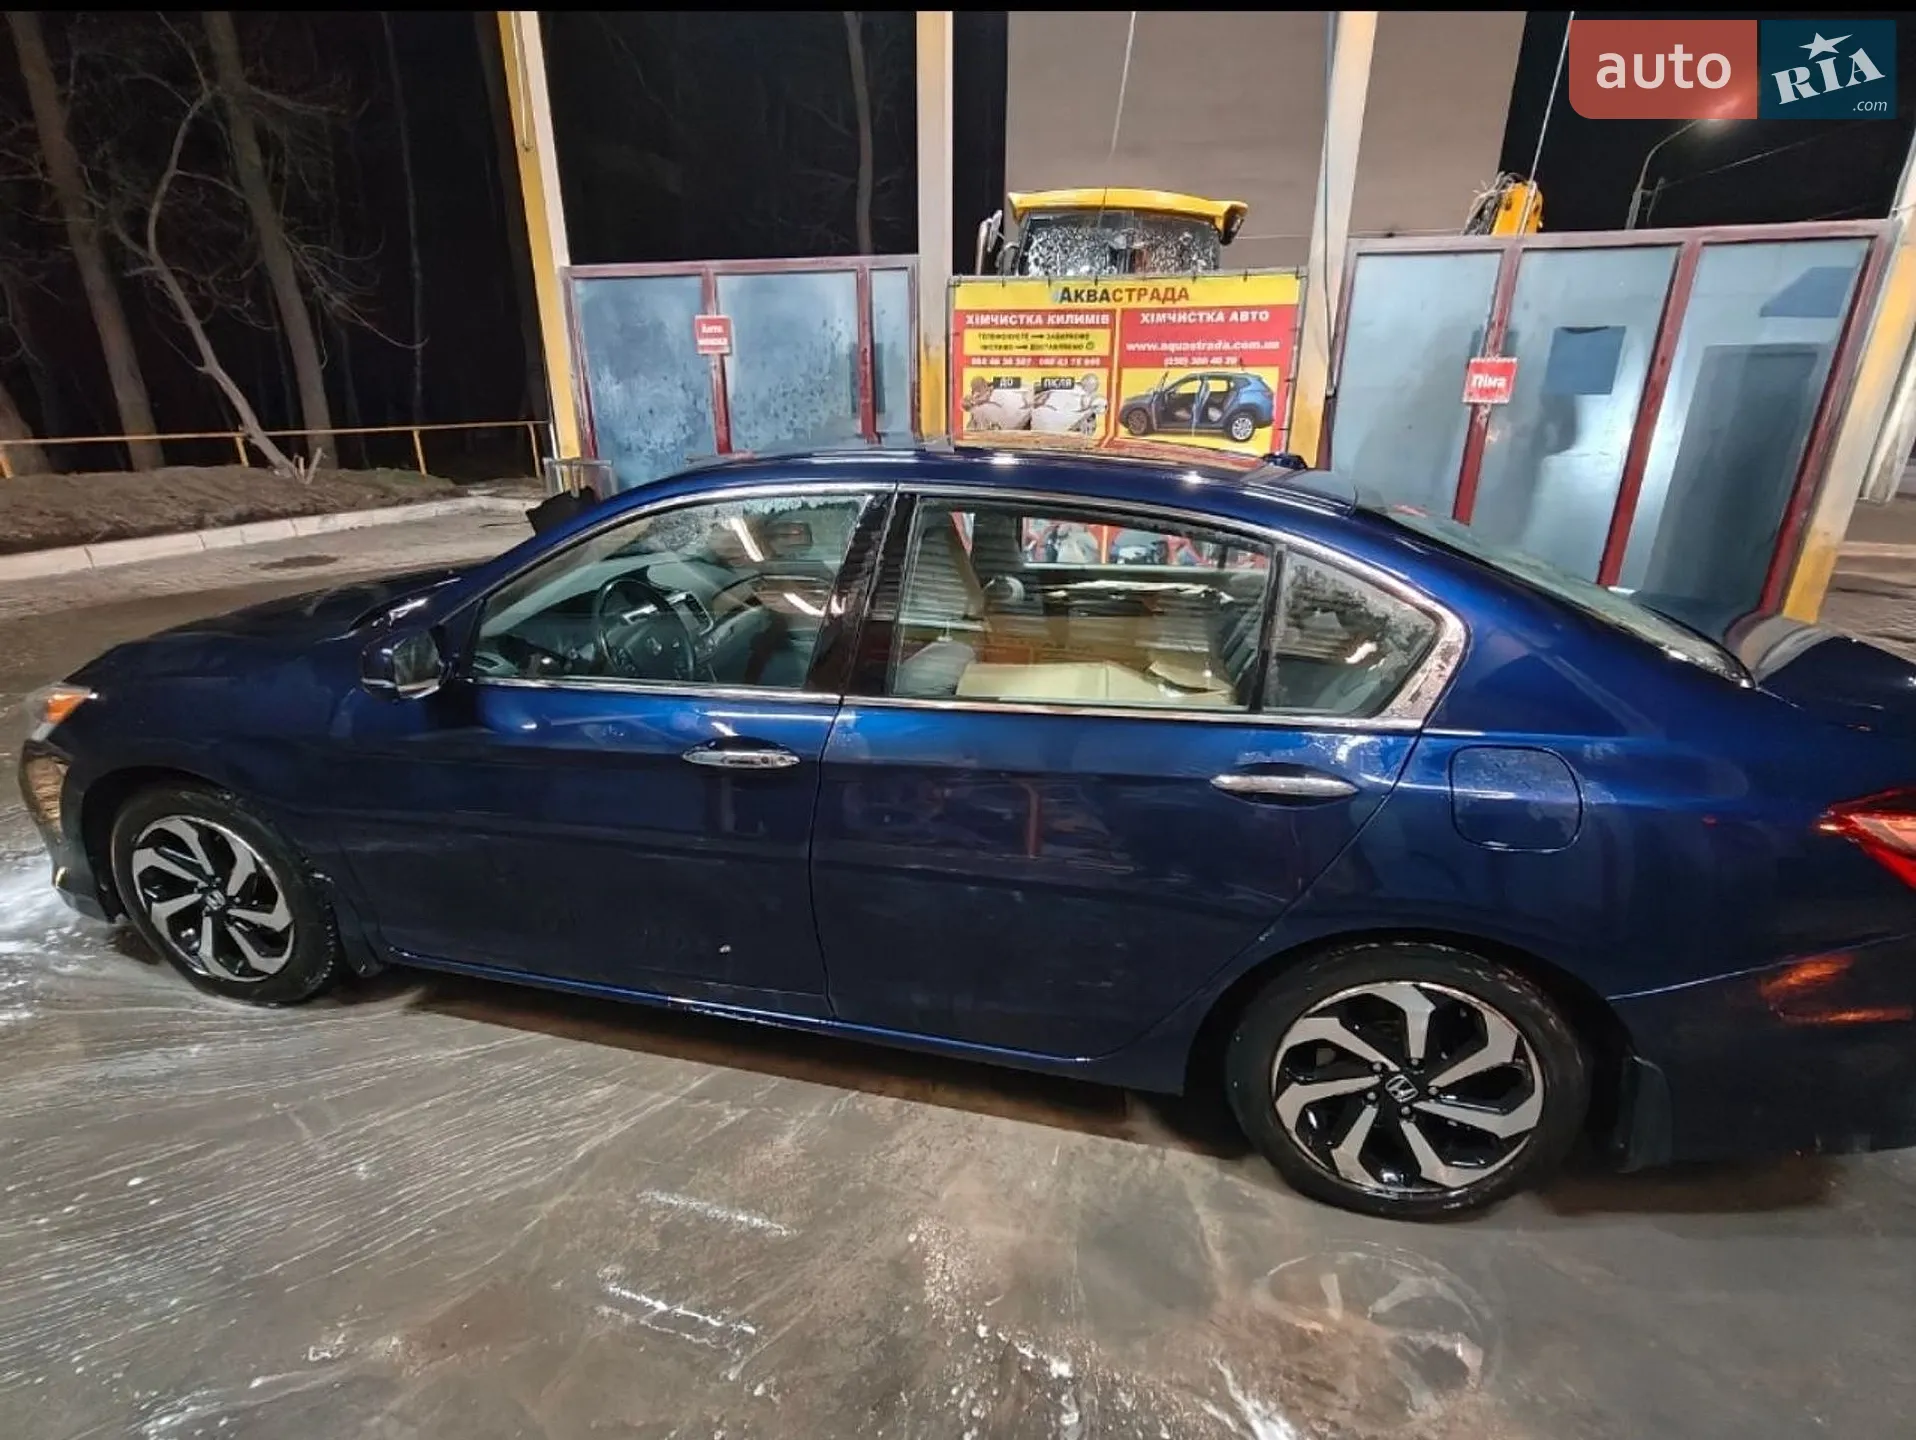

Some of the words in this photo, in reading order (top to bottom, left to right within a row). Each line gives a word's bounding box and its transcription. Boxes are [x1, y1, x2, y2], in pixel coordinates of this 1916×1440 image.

[965, 313, 1043, 326] ХІМЧИСТКА
[1047, 313, 1110, 326] КИЛИМІВ
[1140, 310, 1225, 325] ХІМЧИСТКА
[1229, 310, 1270, 323] АВТО
[999, 377, 1014, 388] ДО
[1471, 372, 1507, 390] Піна
